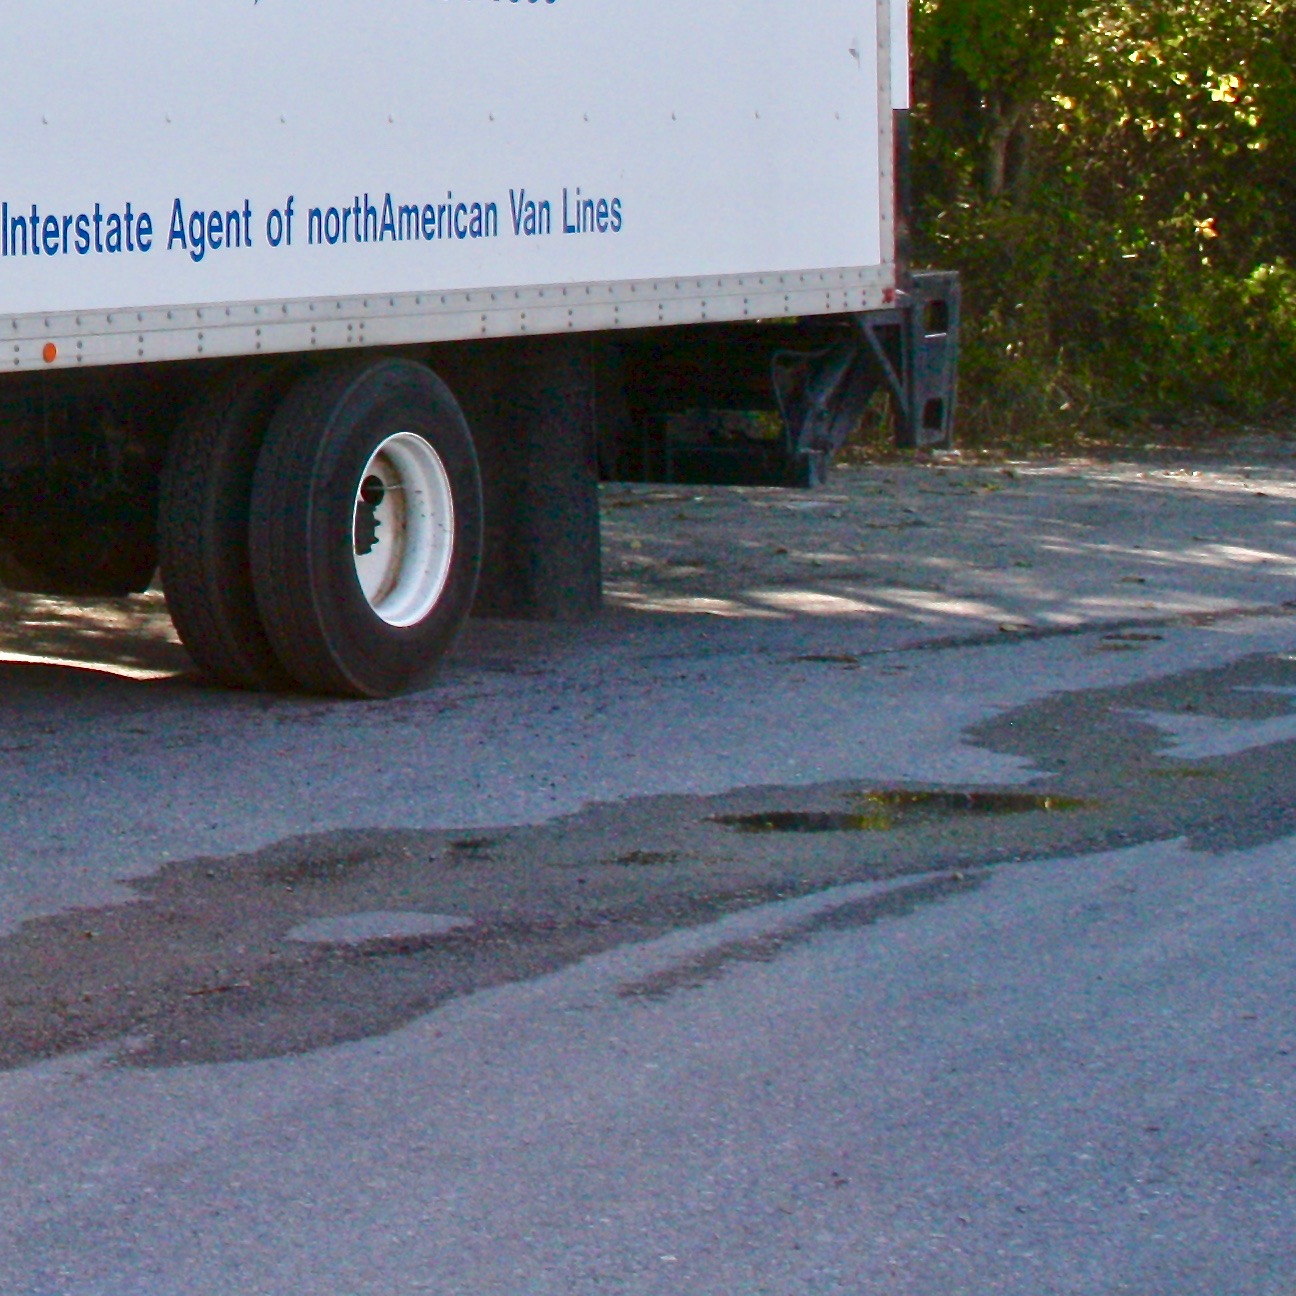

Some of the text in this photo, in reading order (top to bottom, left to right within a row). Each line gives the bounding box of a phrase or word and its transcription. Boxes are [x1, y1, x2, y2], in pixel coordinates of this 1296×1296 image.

[1, 201, 154, 257] Interstate
[166, 197, 253, 263] Agent
[266, 194, 295, 248] of
[307, 190, 499, 246] northAmerican
[508, 188, 552, 237] Van
[562, 187, 624, 234] Lines
